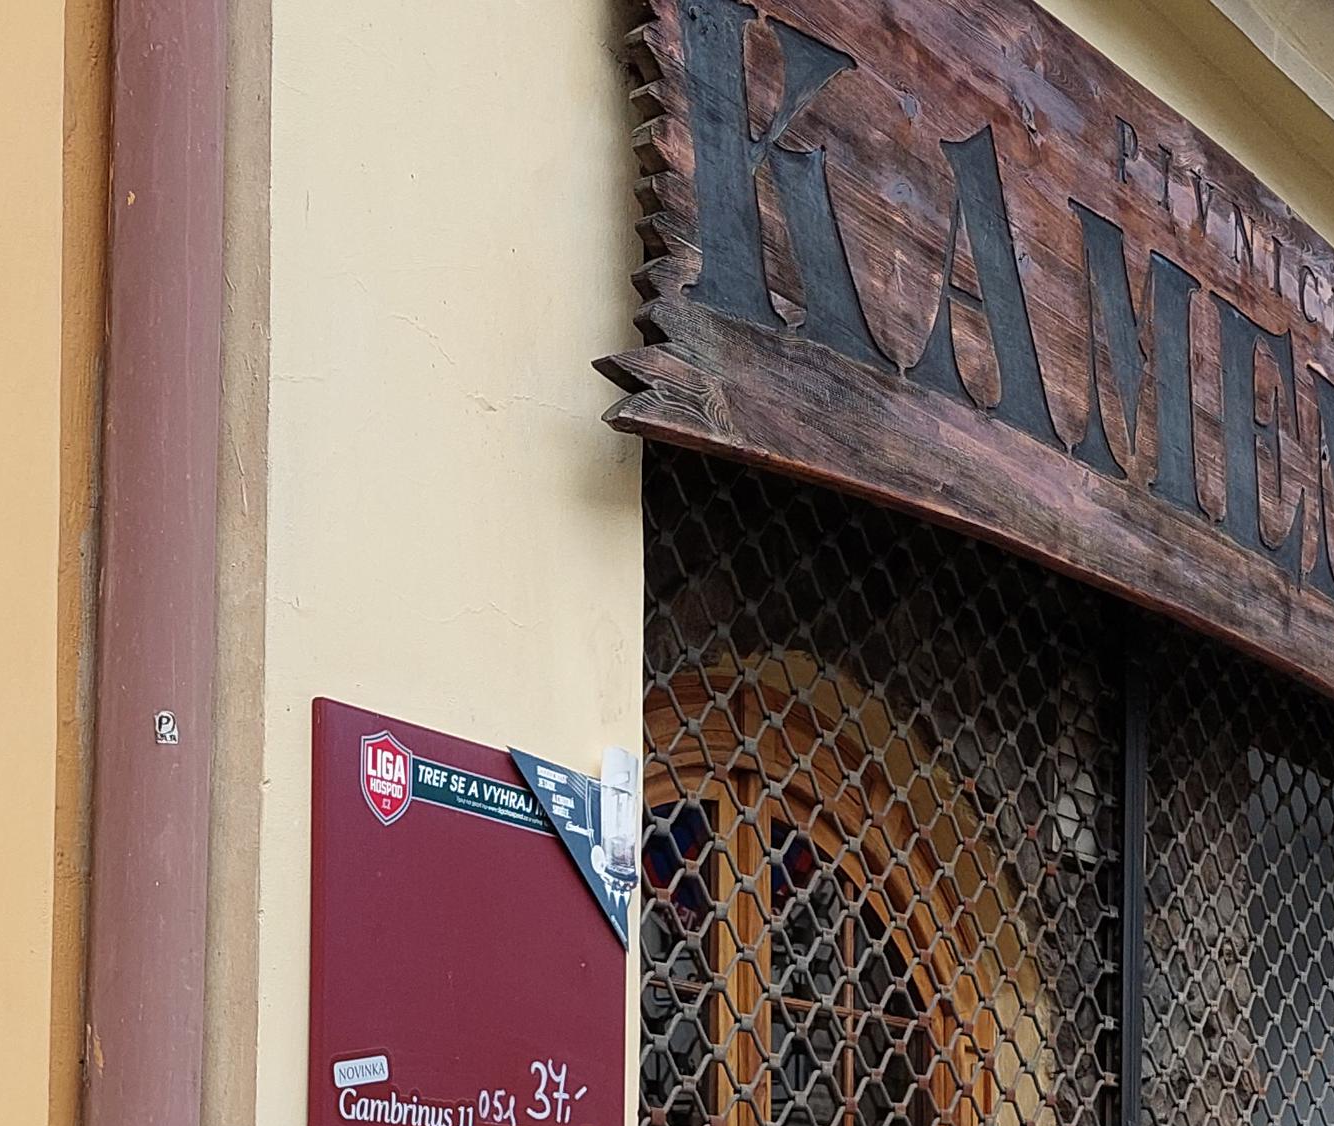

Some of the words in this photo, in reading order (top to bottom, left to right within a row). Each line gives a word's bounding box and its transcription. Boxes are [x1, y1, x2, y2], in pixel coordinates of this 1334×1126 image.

[367, 746, 406, 785] LIGA
[370, 777, 403, 799] HOSPOD
[418, 765, 447, 788] TREF
[450, 775, 466, 795] SE
[468, 781, 479, 799] A
[483, 783, 535, 813] VYHRAJ
[338, 1061, 386, 1082] NOVINKA
